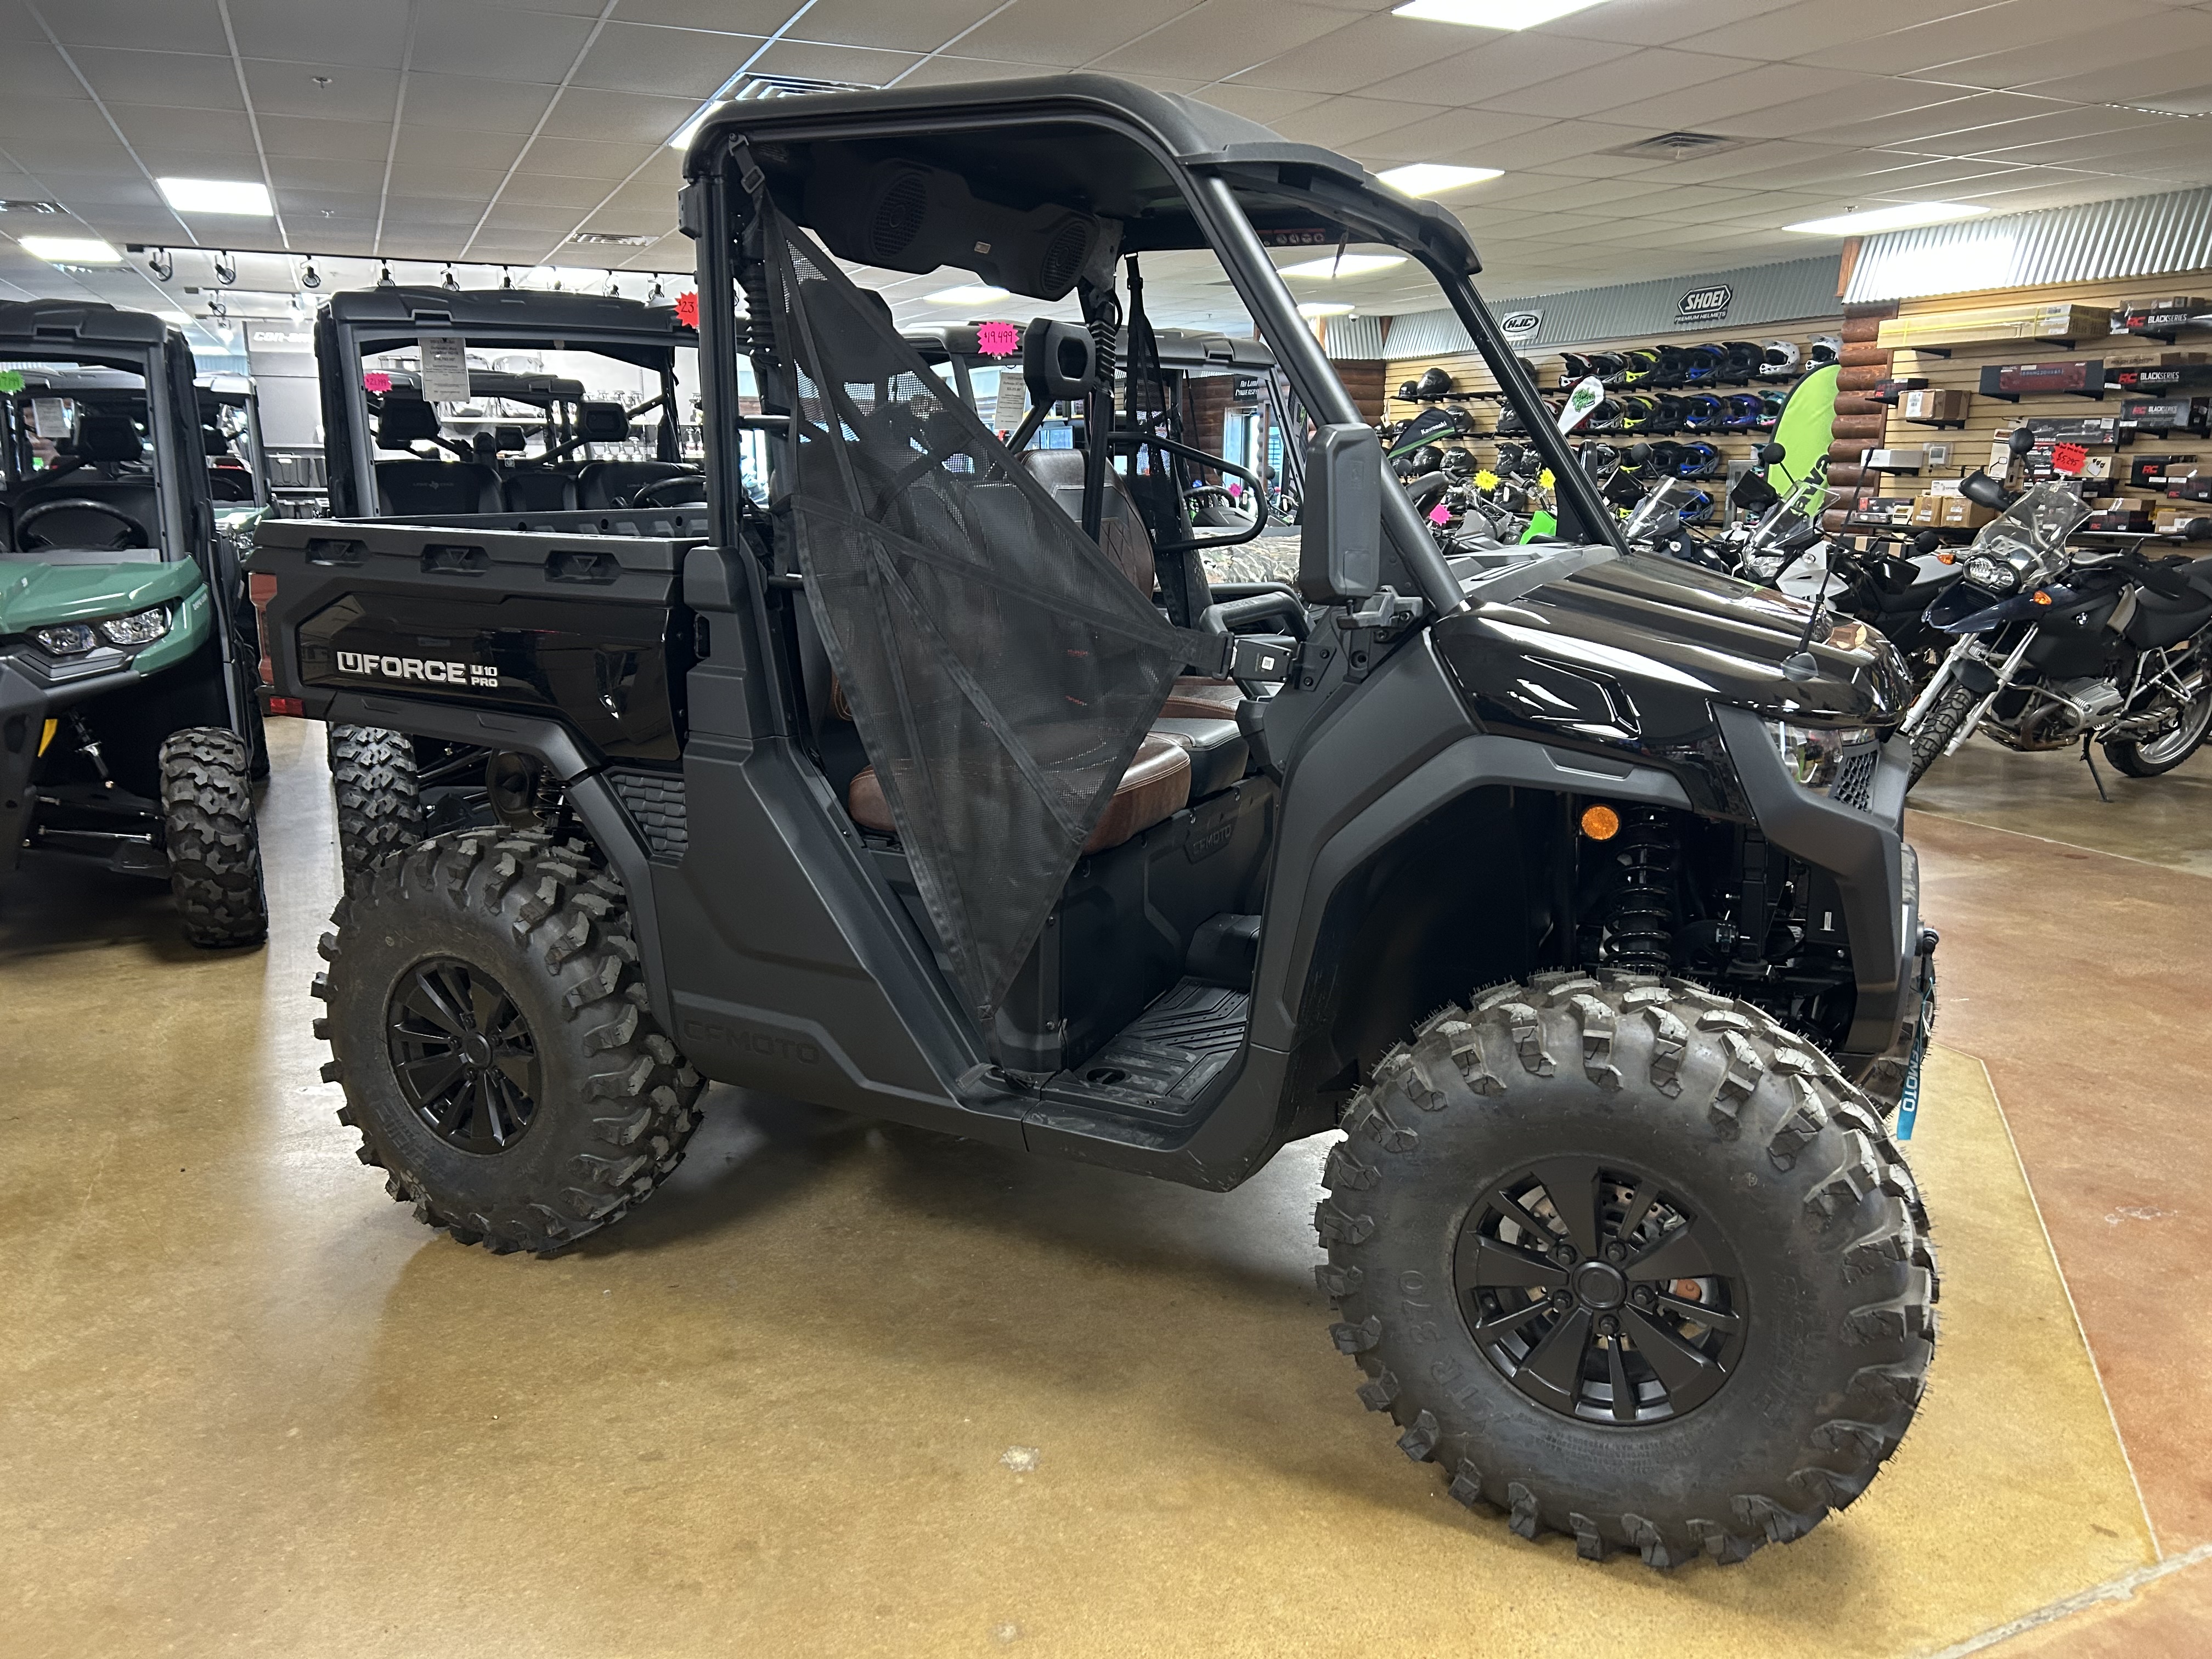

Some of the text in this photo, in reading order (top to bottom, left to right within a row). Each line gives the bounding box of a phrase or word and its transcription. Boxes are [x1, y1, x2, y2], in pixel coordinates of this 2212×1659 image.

[1685, 290, 1724, 310] SHOEI
[1700, 311, 1726, 319] HELMETS
[1507, 318, 1533, 328] HJC
[2118, 373, 2138, 383] RC
[1420, 420, 1447, 435] Kawasaki
[2142, 465, 2159, 474] RC
[470, 664, 497, 676] U10
[471, 676, 498, 687] PRO
[684, 1019, 821, 1065] CFMOTO
[1902, 1037, 1920, 1113] CFMOTO
